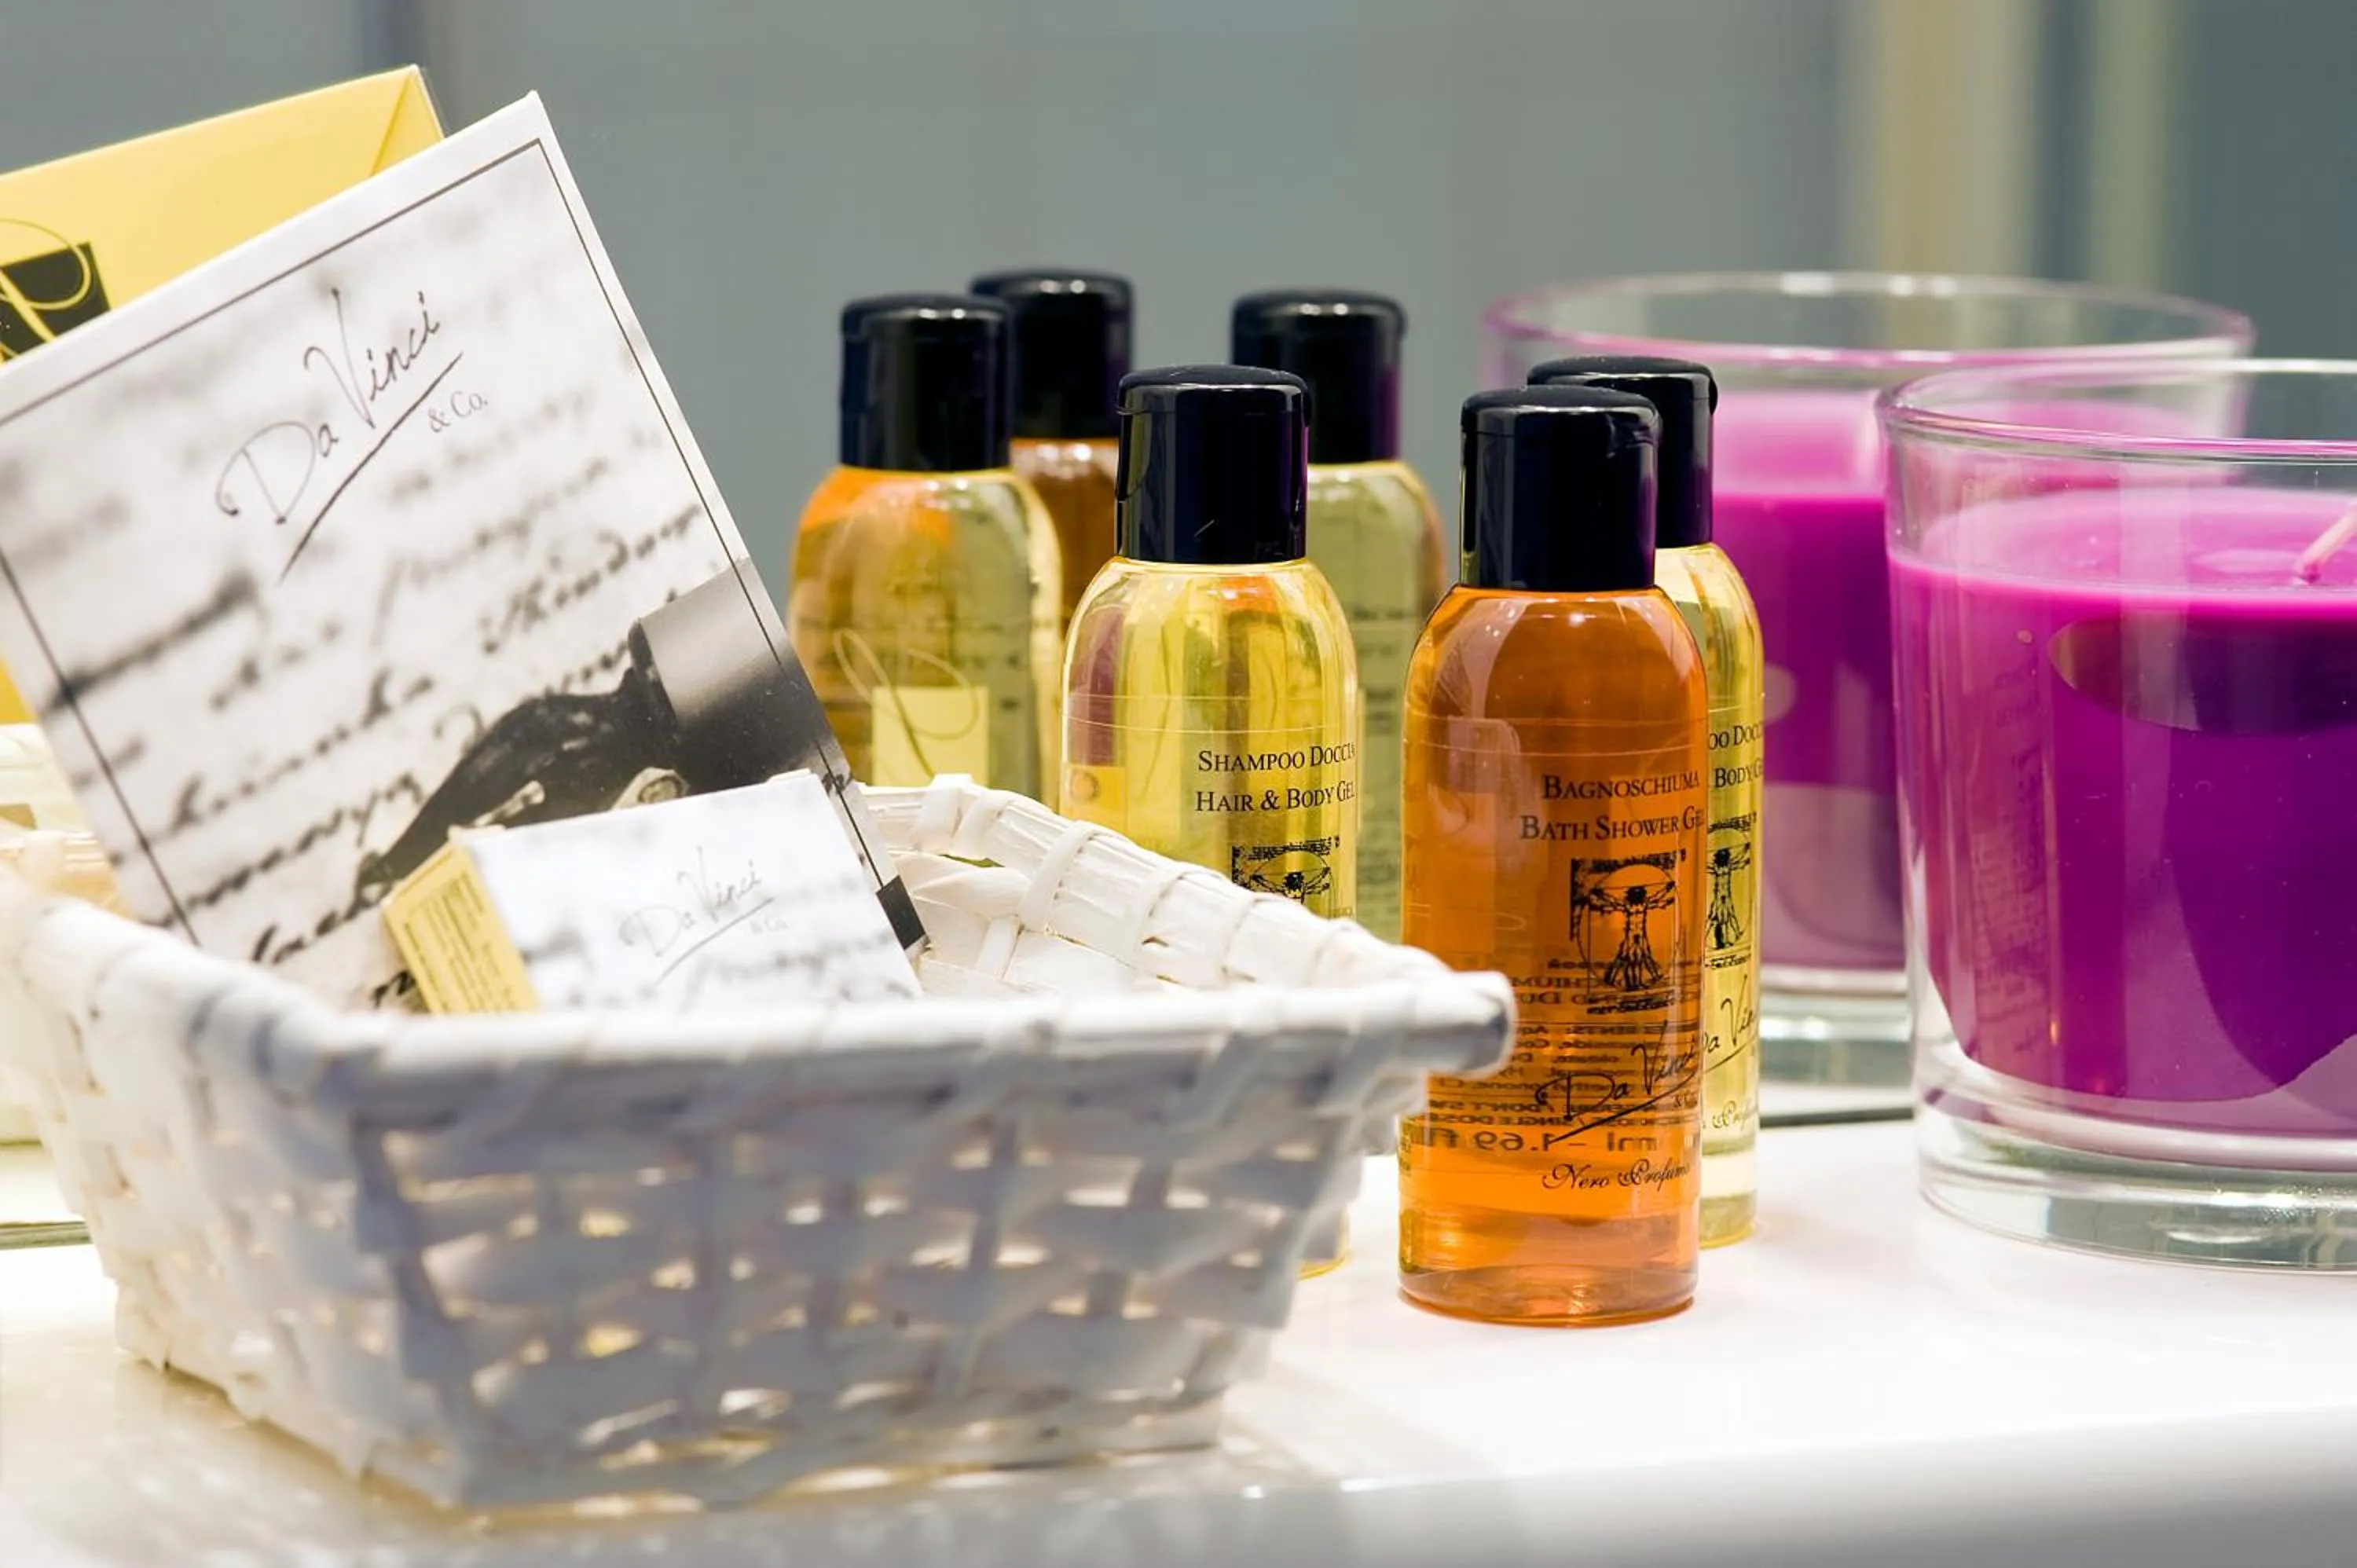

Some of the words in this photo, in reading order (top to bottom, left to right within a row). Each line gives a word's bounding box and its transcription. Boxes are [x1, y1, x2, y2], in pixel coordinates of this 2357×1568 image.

[215, 420, 339, 526] Da
[304, 288, 440, 429] Vinci
[1198, 750, 1306, 772] SHAMPOO
[1543, 771, 1699, 800] BAGNOSCHIUMA
[1714, 765, 1754, 788] BODY
[1195, 791, 1255, 811] HAIR
[1260, 789, 1280, 811] &
[1286, 787, 1334, 809] BODY
[1519, 815, 1588, 841] BATH
[1596, 814, 1679, 841] SHOWER
[618, 903, 696, 958] Da
[676, 844, 762, 925] Vinci
[1535, 1072, 1629, 1123] Da
[1631, 1020, 1695, 1096] Vinci
[1541, 1163, 1610, 1190] Nero
